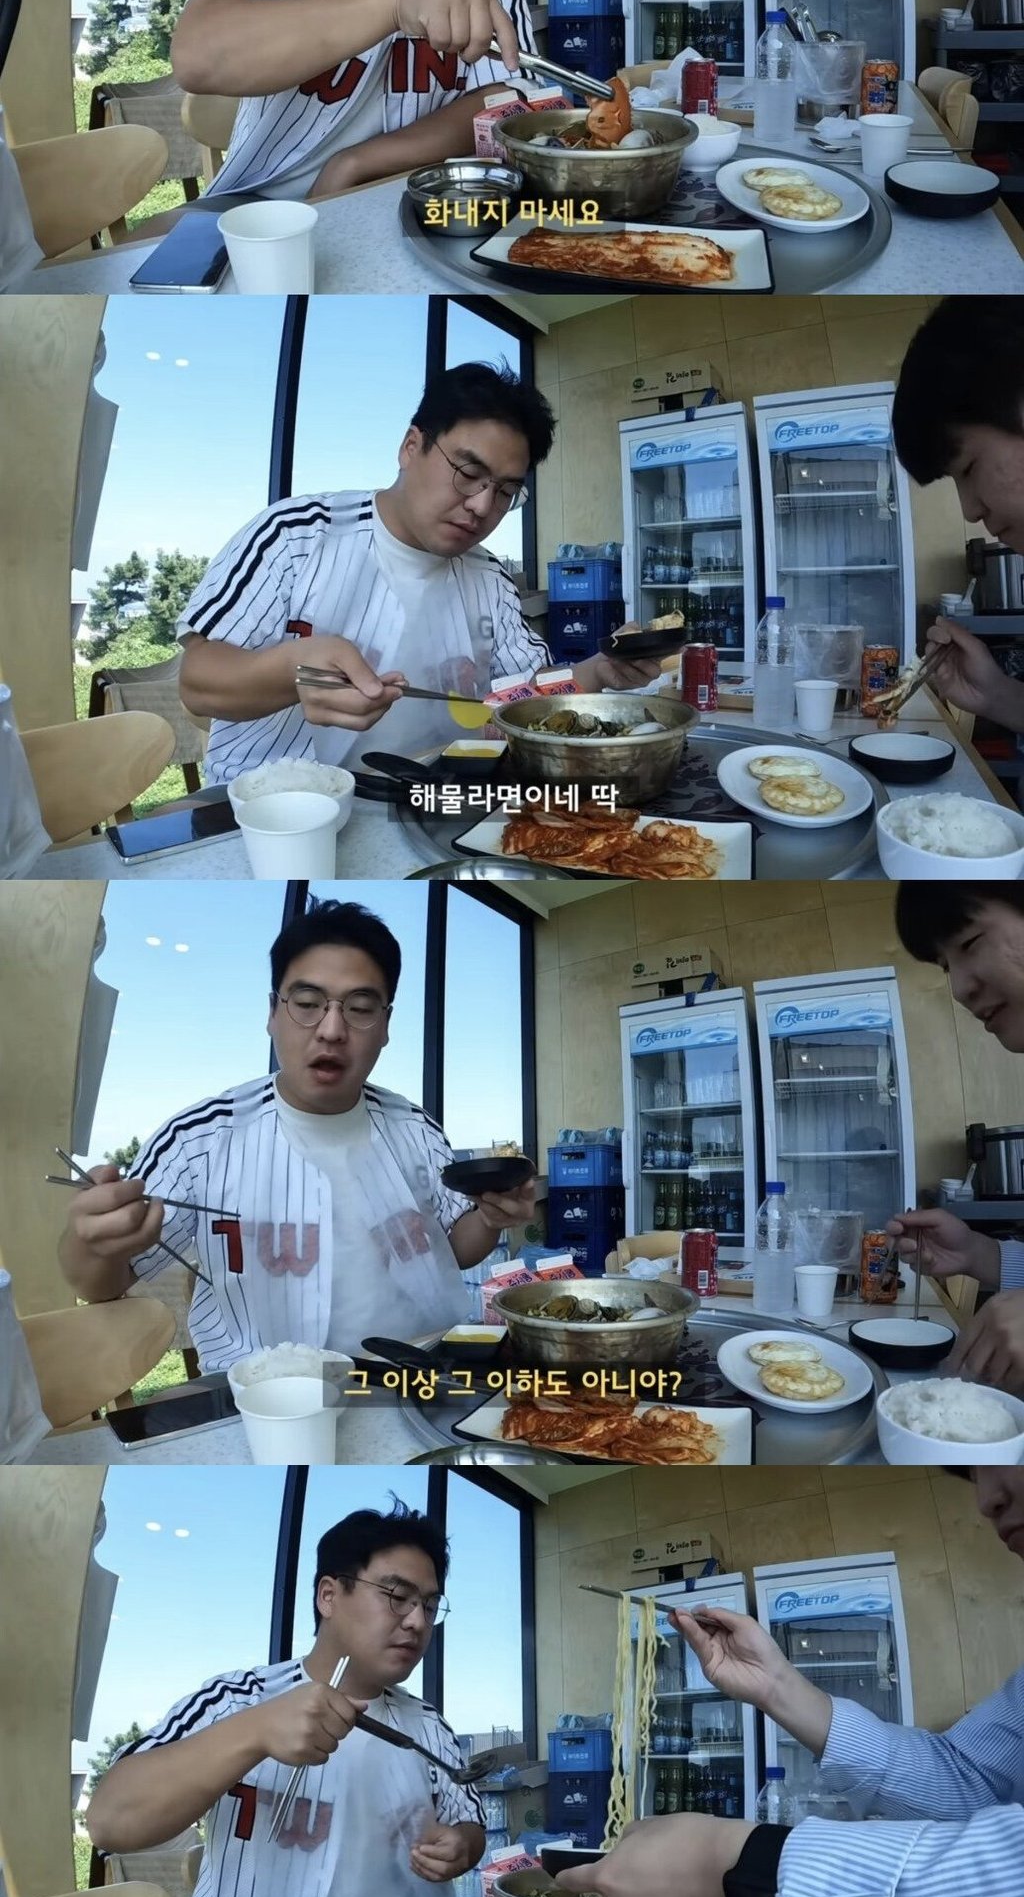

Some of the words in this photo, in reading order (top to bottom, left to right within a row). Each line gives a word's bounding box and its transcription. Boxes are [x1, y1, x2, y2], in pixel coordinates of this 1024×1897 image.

[778, 423, 840, 440] FREETOP
[778, 1008, 840, 1025] FREETOP
[778, 1594, 840, 1611] FREETOP
